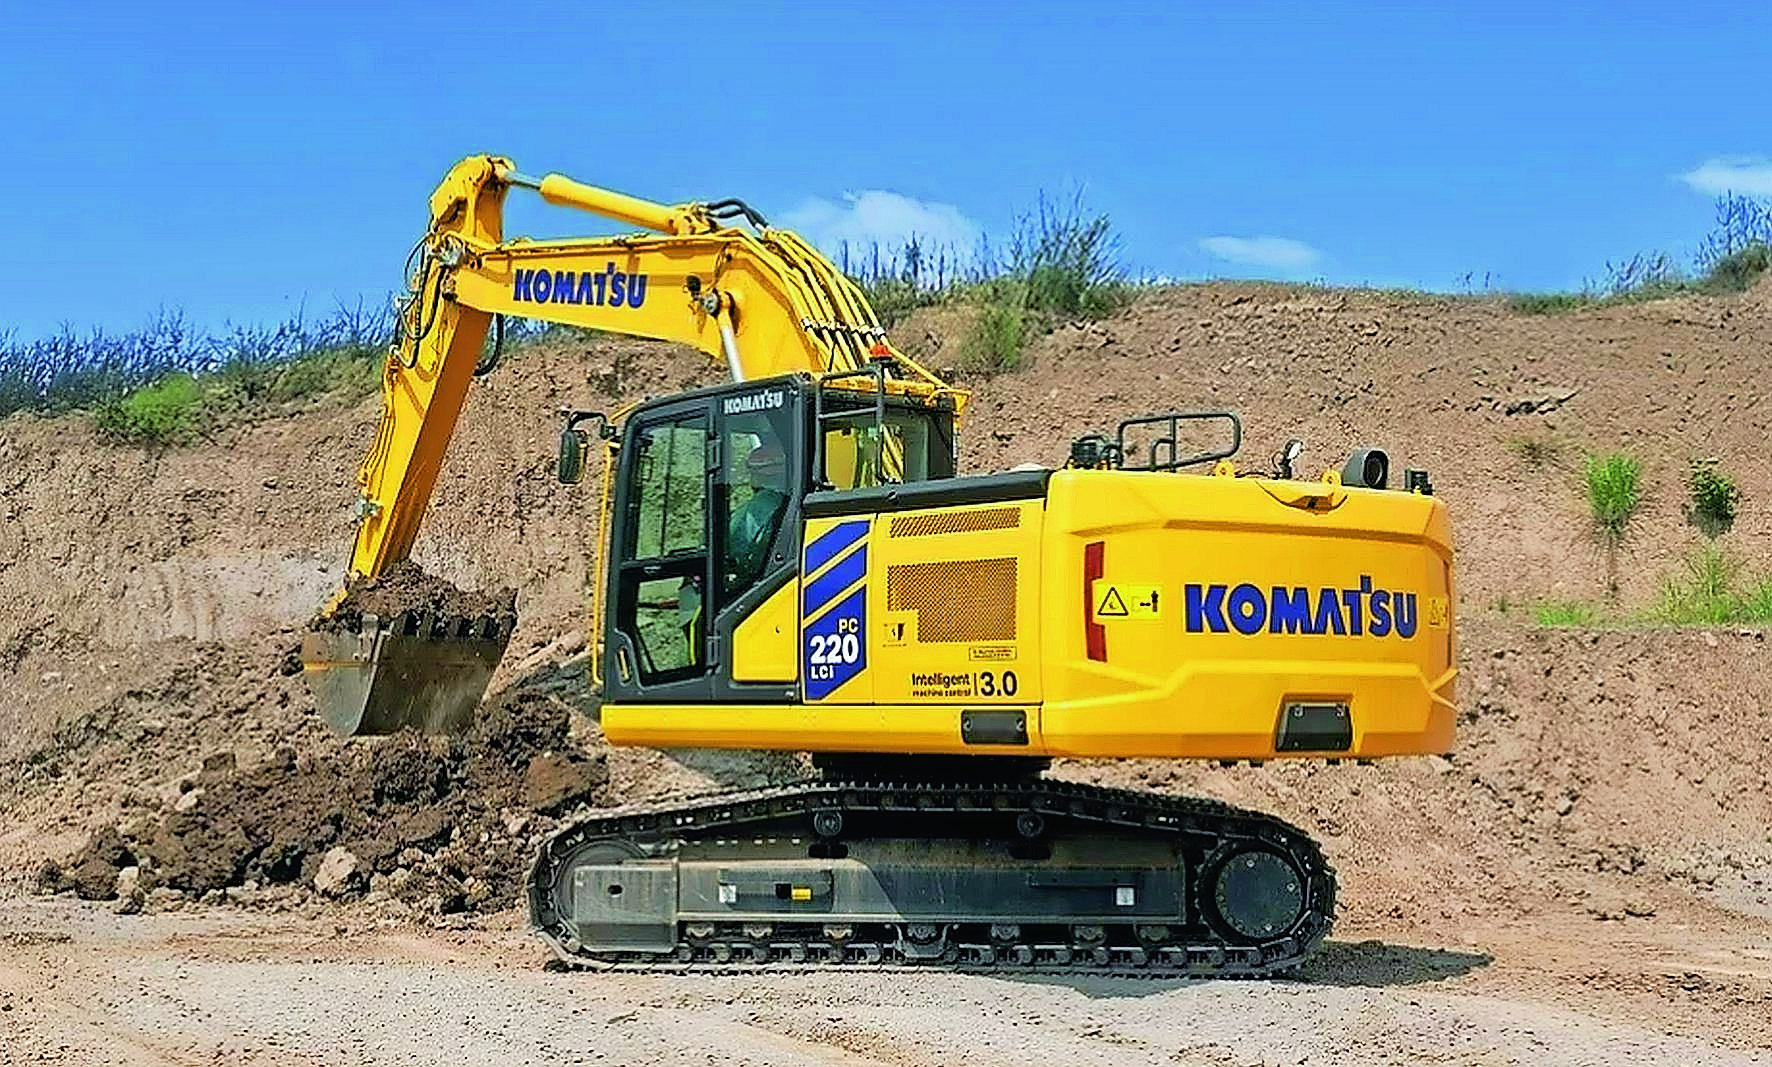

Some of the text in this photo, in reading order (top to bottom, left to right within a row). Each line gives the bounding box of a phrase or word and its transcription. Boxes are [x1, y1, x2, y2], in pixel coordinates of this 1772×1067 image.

[513, 262, 647, 308] KOMATSU
[724, 390, 783, 414] KOMATSU
[1184, 575, 1417, 638] KOMATSU
[838, 618, 859, 634] PC
[809, 634, 859, 664] 220
[911, 672, 971, 689] Intelligent
[980, 671, 1017, 697] 3.0
